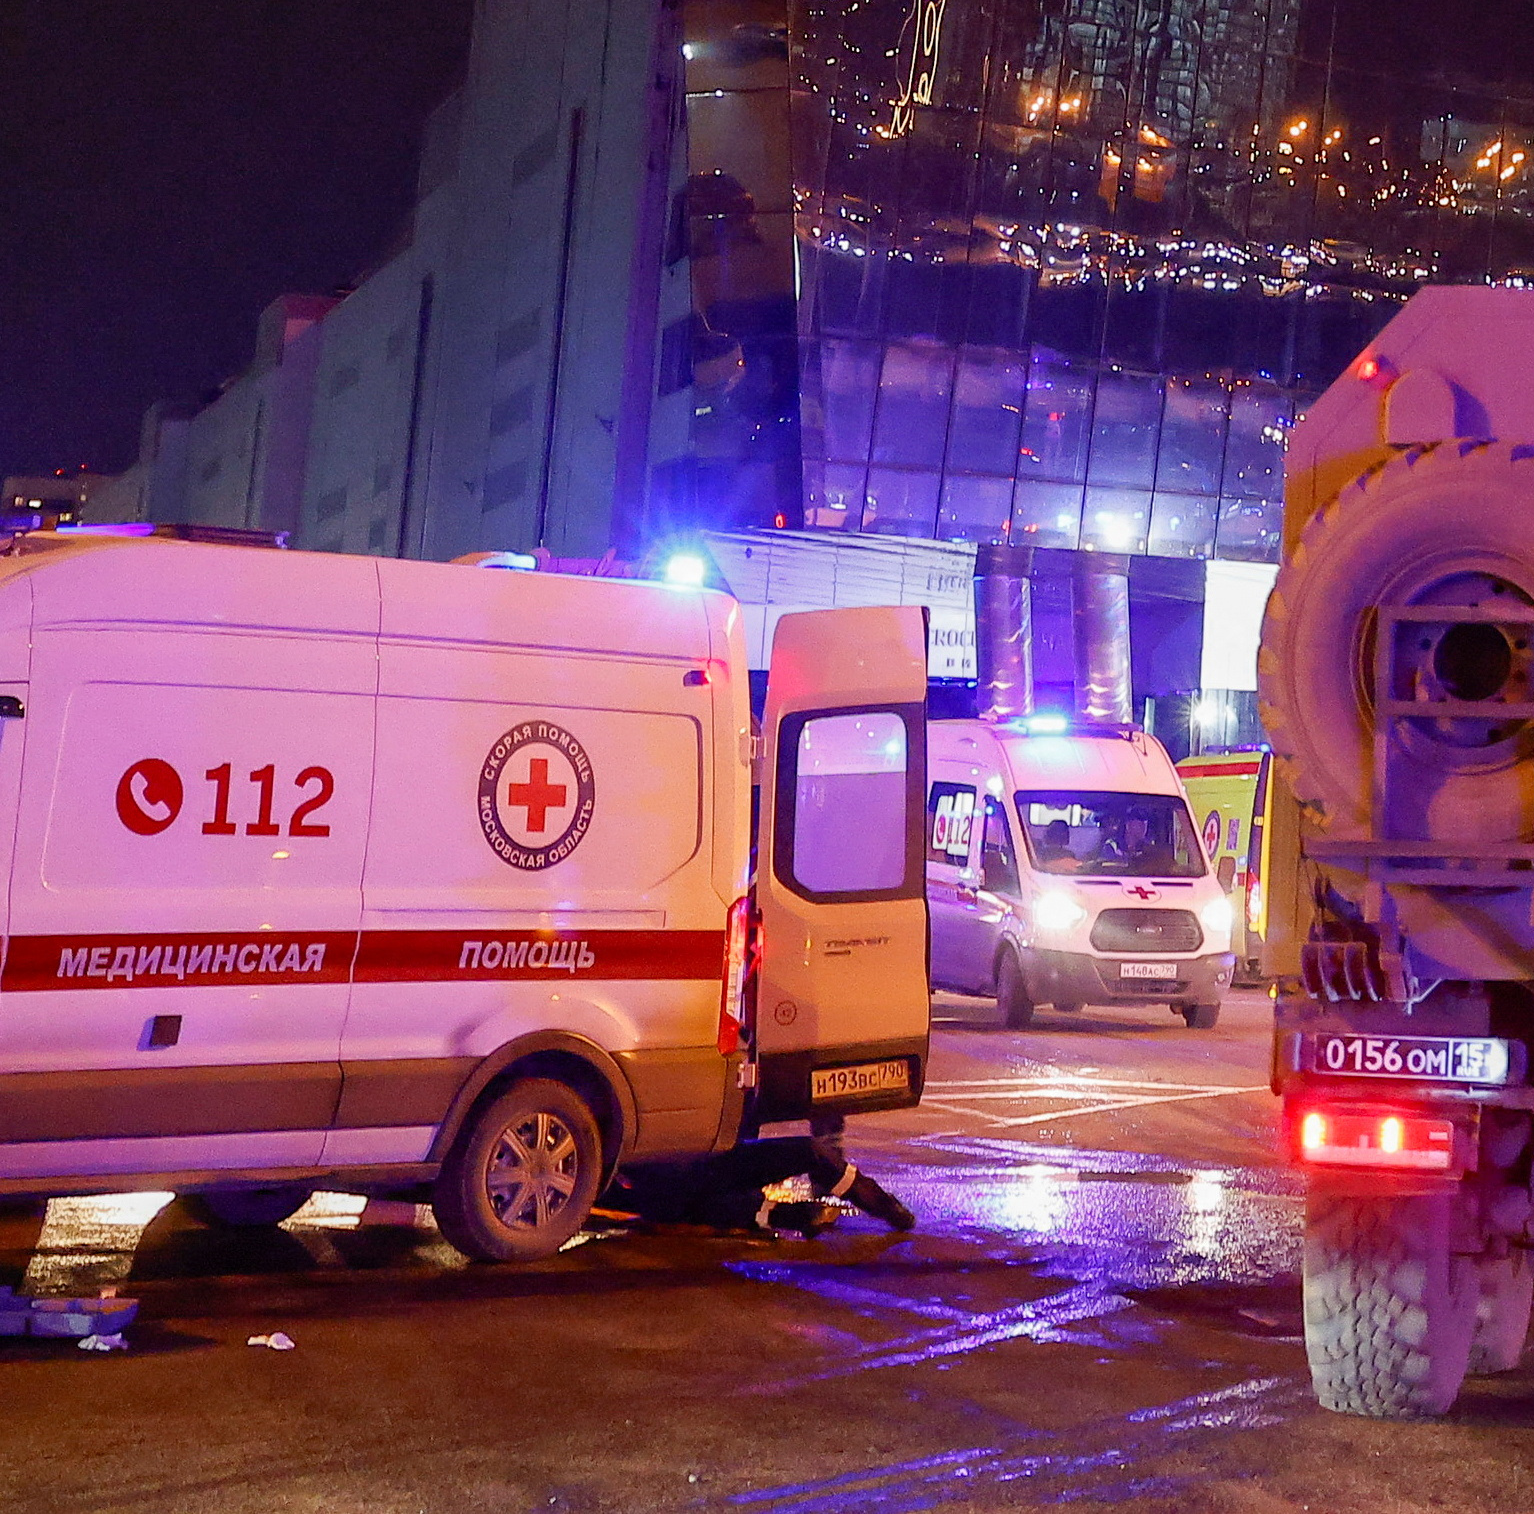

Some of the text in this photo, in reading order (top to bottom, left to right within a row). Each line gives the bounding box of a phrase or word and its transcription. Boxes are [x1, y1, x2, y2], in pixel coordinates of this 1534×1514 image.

[484, 724, 590, 783] СКОРАЯ ПОМОЩЬ
[202, 762, 334, 837] 112
[481, 796, 593, 868] МОСКОВСКАЯ ОБЛАСТЬ
[57, 939, 596, 982] МЕДИЦИНСКАЯ ПОМОЩЬ
